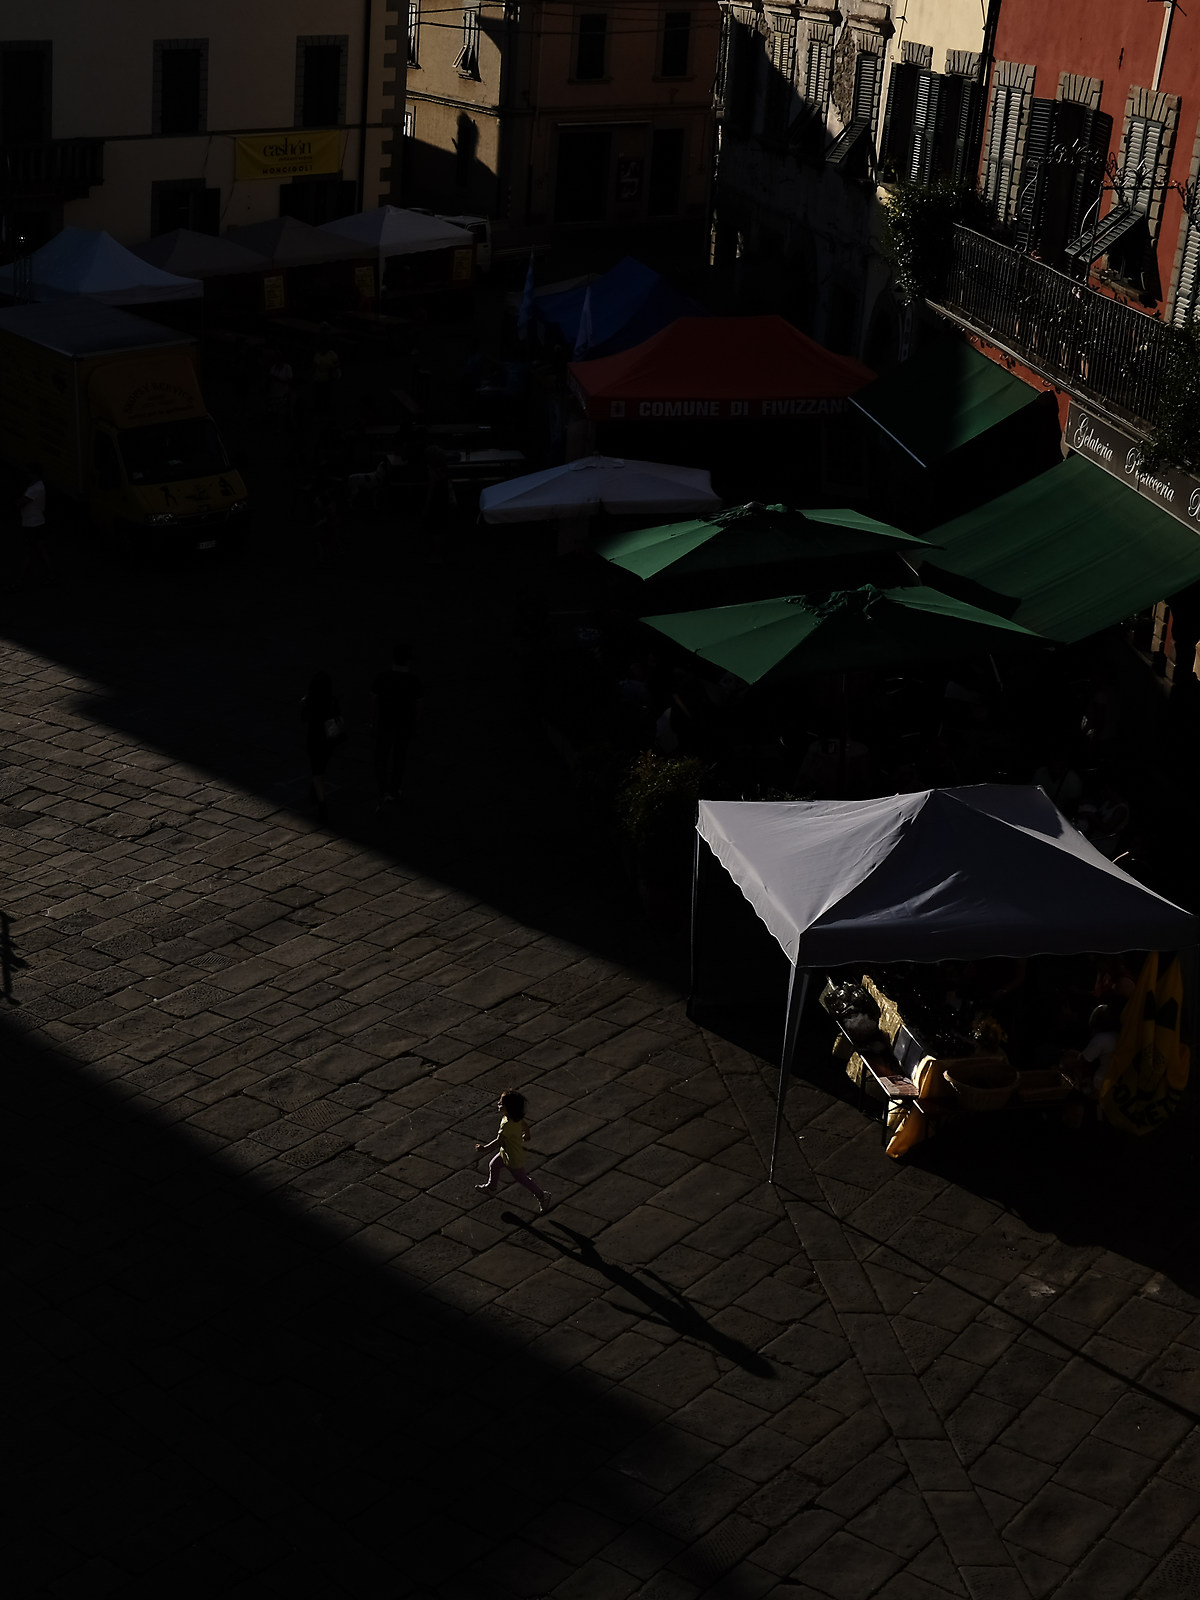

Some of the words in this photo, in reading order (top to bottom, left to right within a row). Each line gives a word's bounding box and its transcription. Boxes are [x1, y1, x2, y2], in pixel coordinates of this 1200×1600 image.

[639, 401, 720, 417] COMUNE
[730, 400, 749, 417] DI
[1073, 412, 1113, 462] Gelateria
